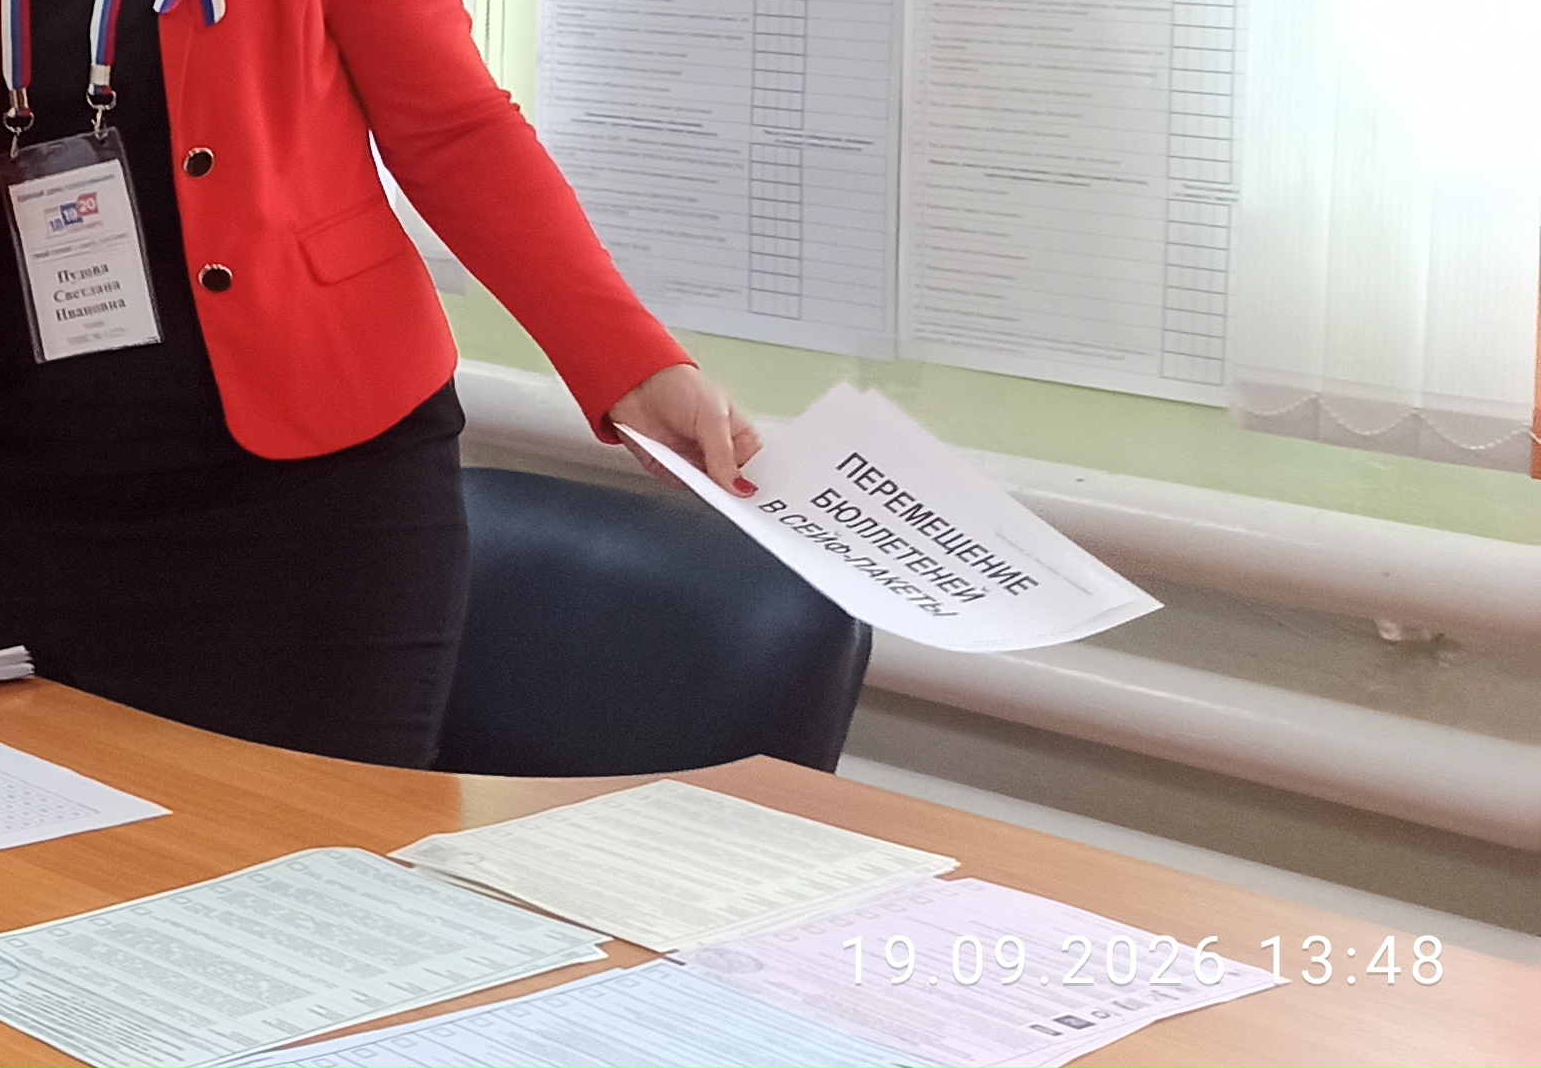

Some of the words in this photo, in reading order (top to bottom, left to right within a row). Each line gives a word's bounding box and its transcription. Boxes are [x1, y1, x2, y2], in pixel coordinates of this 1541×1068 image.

[756, 498, 787, 515] В
[778, 510, 961, 618] СЕЙФ-ПАКЕТЫ
[810, 487, 988, 605] БЮЛЛЕТЕНЕЙ
[836, 451, 1039, 597] ПЕРЕМЕЩЕНИЕ
